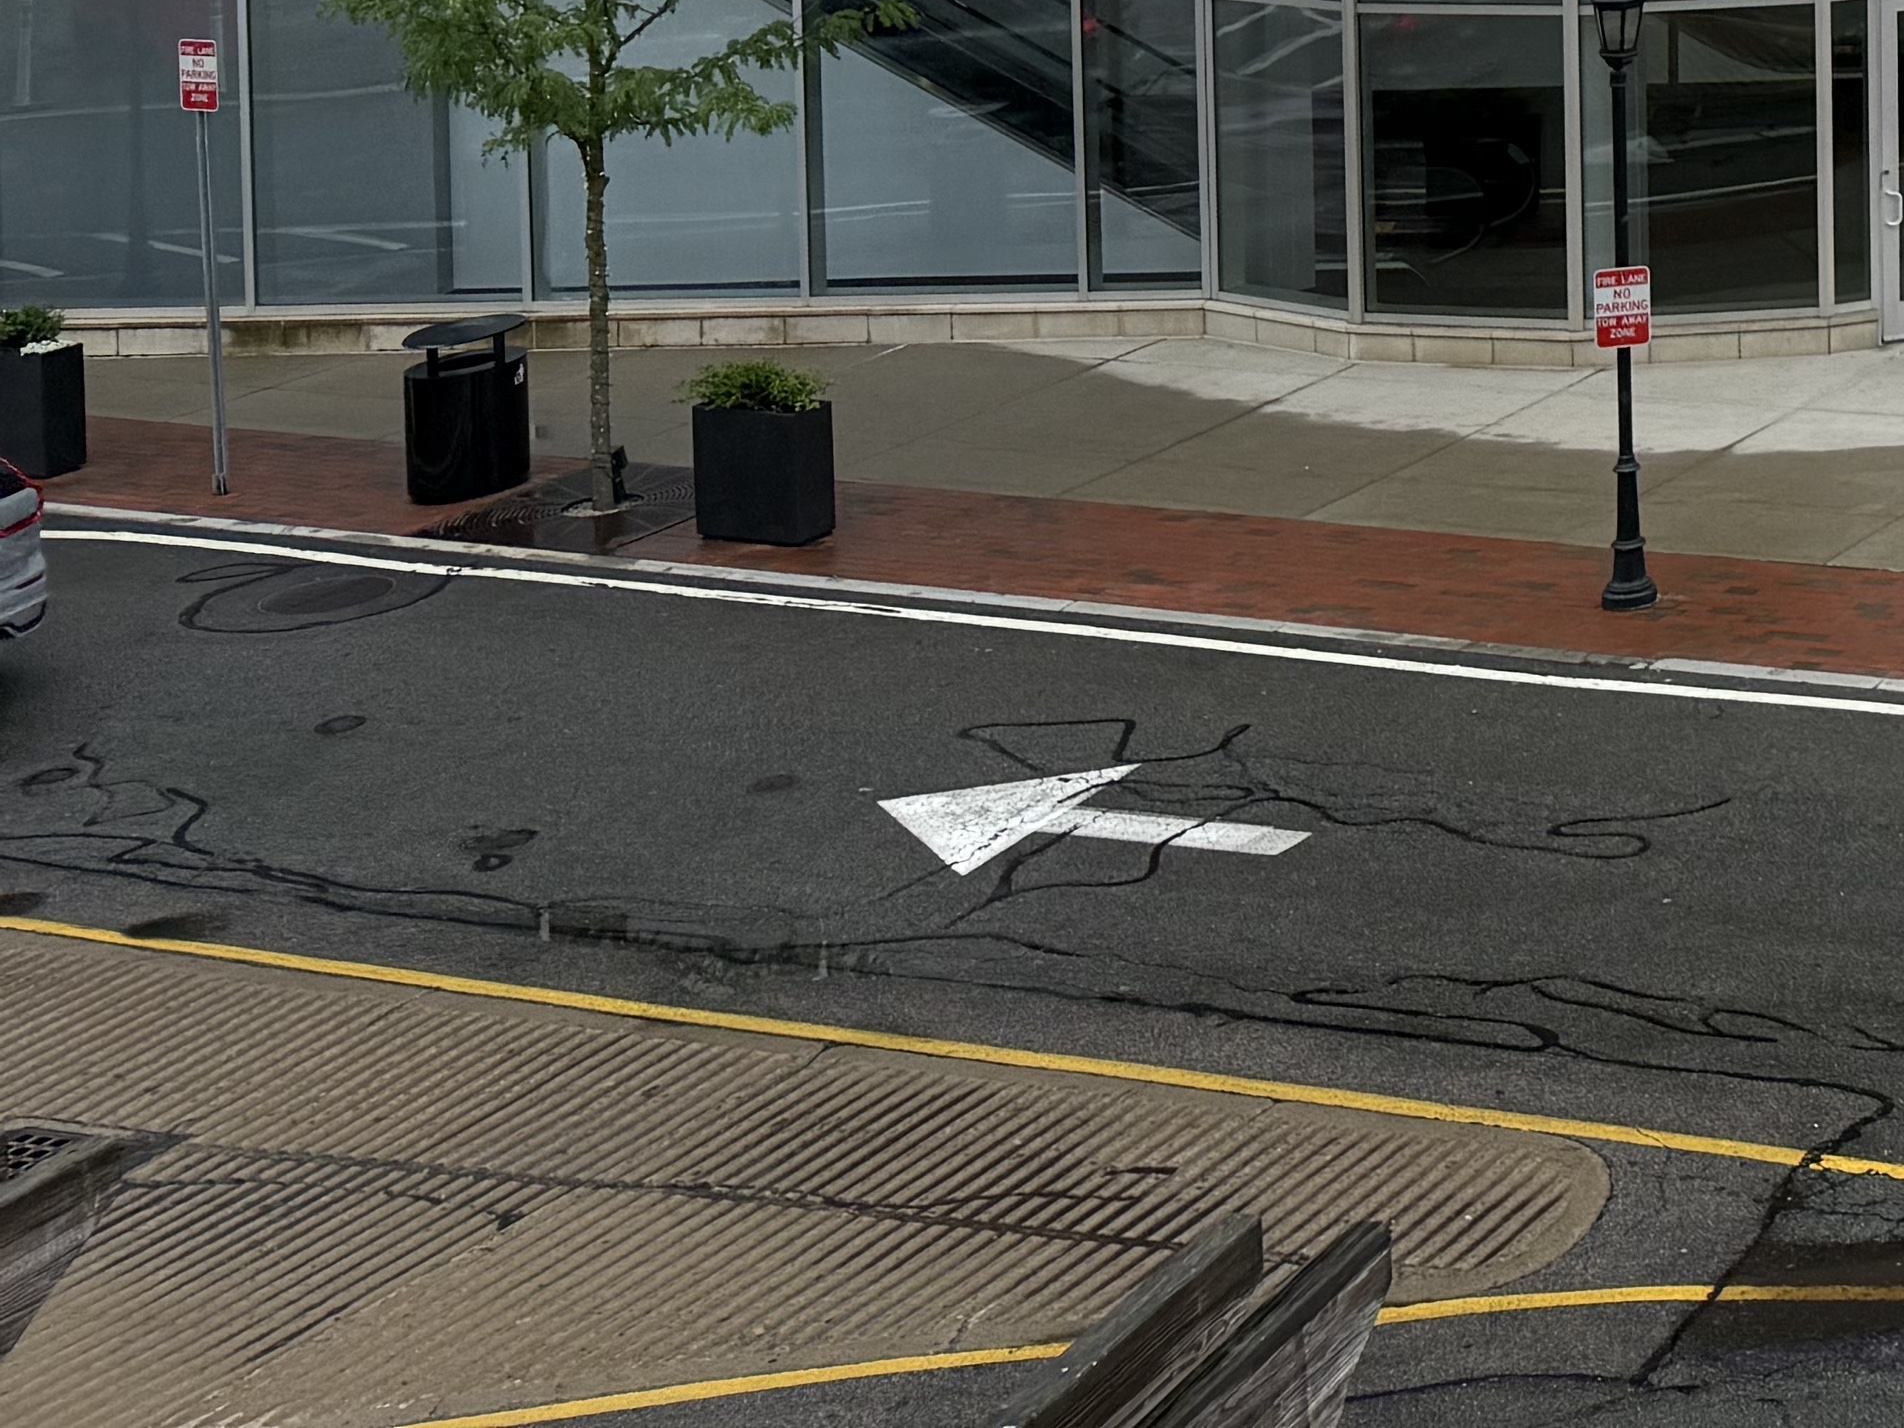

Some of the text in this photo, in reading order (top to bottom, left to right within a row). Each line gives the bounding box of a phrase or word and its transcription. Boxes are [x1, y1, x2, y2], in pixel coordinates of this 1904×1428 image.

[192, 58, 205, 69] NO
[181, 69, 216, 80] PARKING
[1597, 272, 1647, 287] FIRE LANE
[1613, 288, 1631, 299] NO
[1596, 299, 1649, 314] PARKING
[1598, 314, 1648, 327] TOW AWAY
[1610, 327, 1636, 338] ZONE
